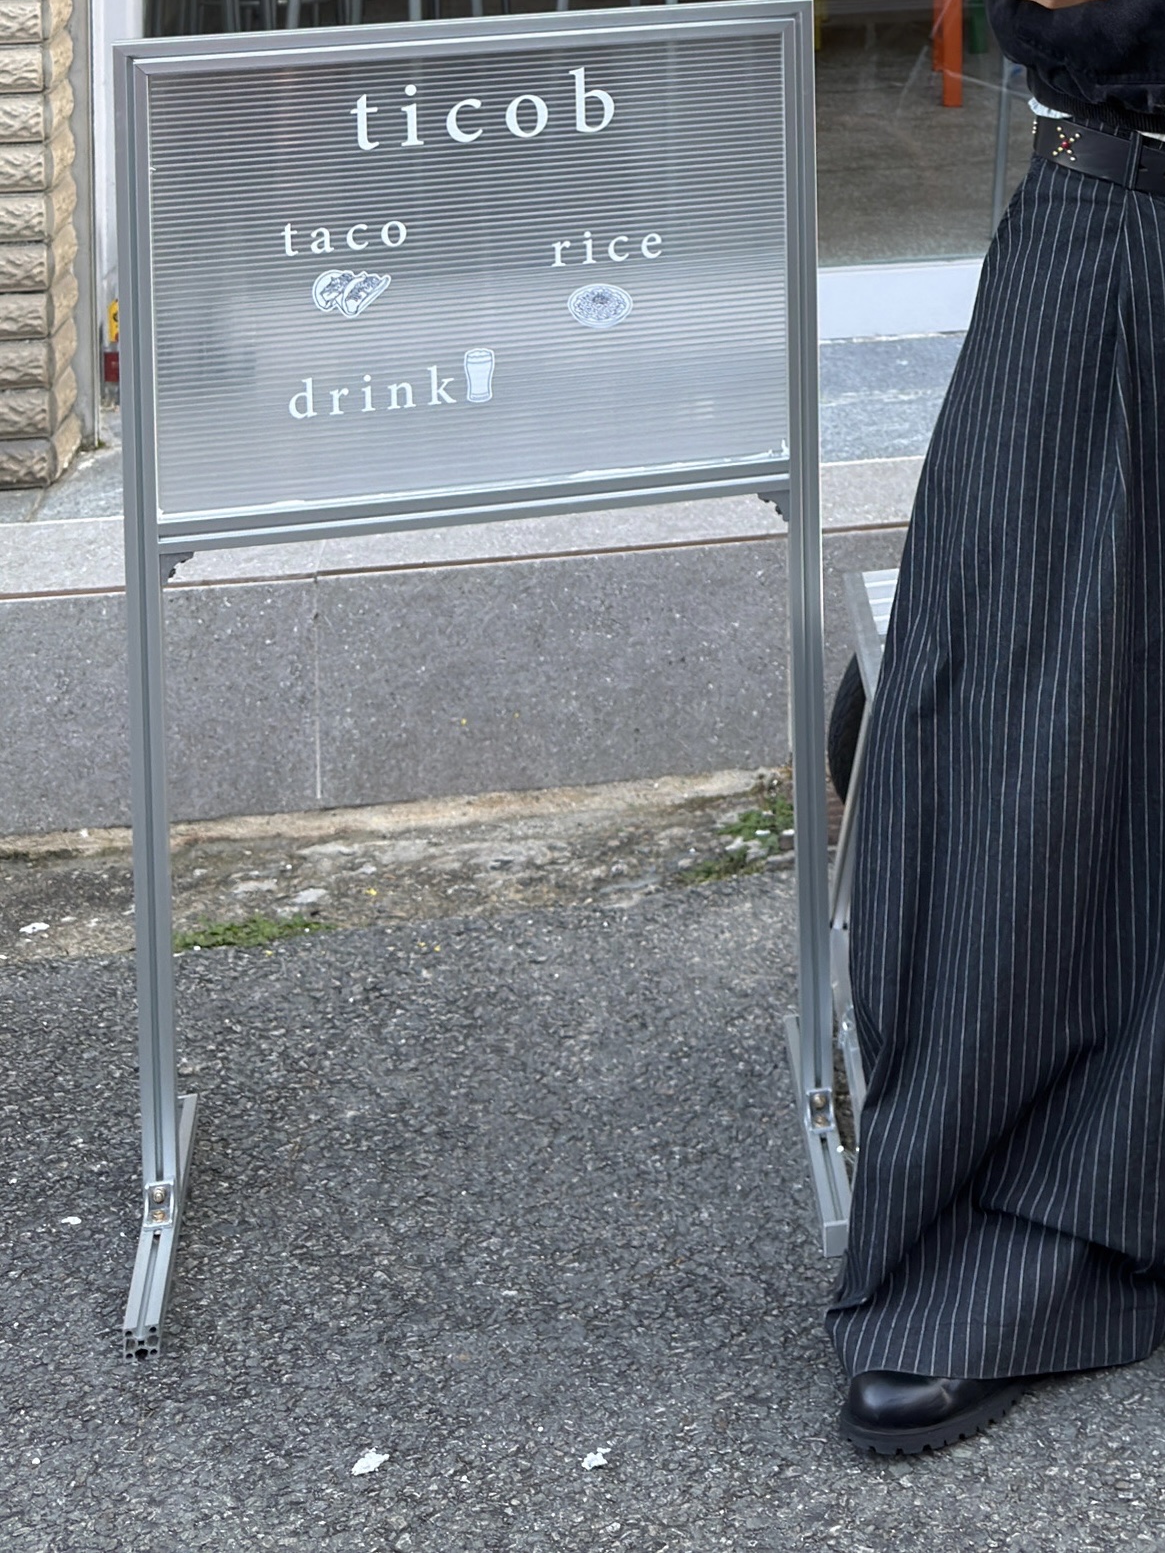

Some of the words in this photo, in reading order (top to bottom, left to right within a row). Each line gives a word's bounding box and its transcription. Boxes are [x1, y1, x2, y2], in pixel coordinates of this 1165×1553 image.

[350, 67, 615, 150] ticob
[282, 220, 407, 257] taco
[551, 231, 662, 267] rice
[288, 365, 457, 419] drink
